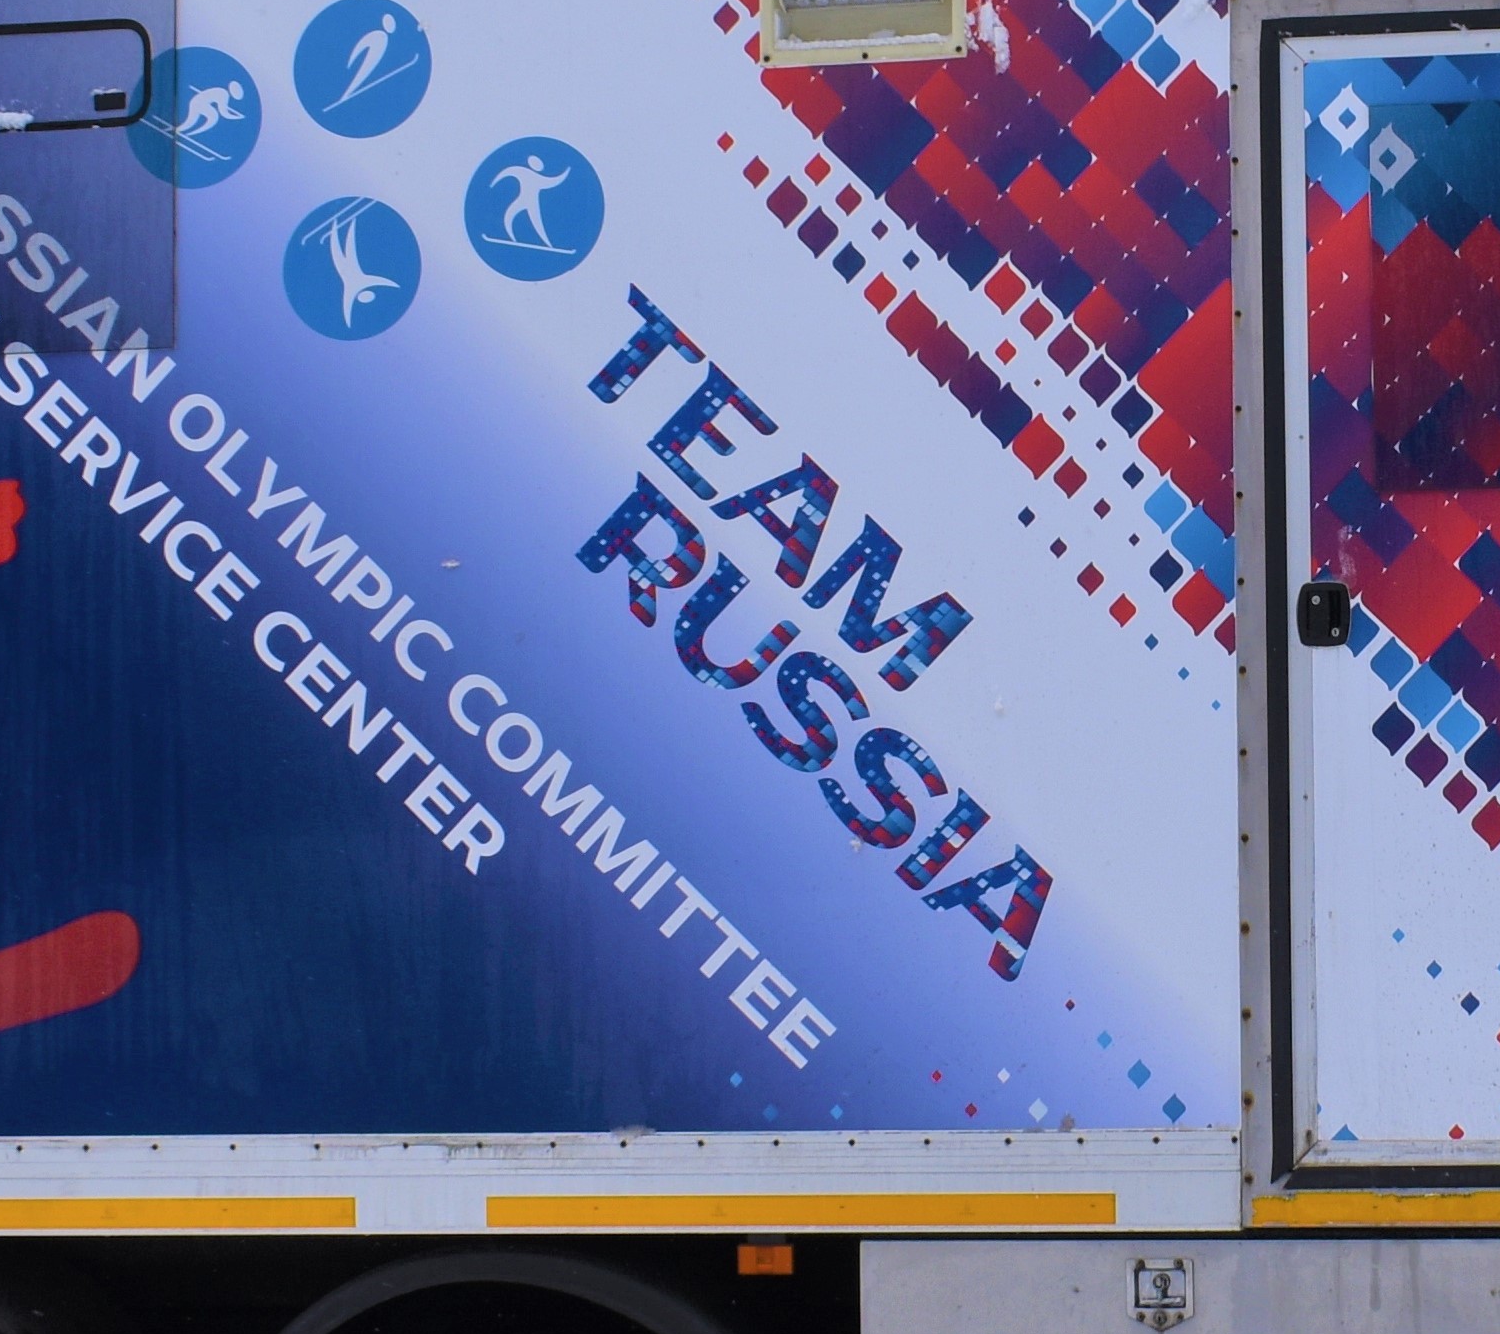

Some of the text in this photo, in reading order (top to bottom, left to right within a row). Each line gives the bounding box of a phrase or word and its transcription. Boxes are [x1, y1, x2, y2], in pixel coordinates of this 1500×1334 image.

[587, 282, 974, 692] TEAM
[168, 393, 454, 682] OLYMPIC
[448, 673, 837, 1070] COMMITTEE
[253, 610, 506, 876] CENTER
[575, 471, 1054, 982] RUSSIA
